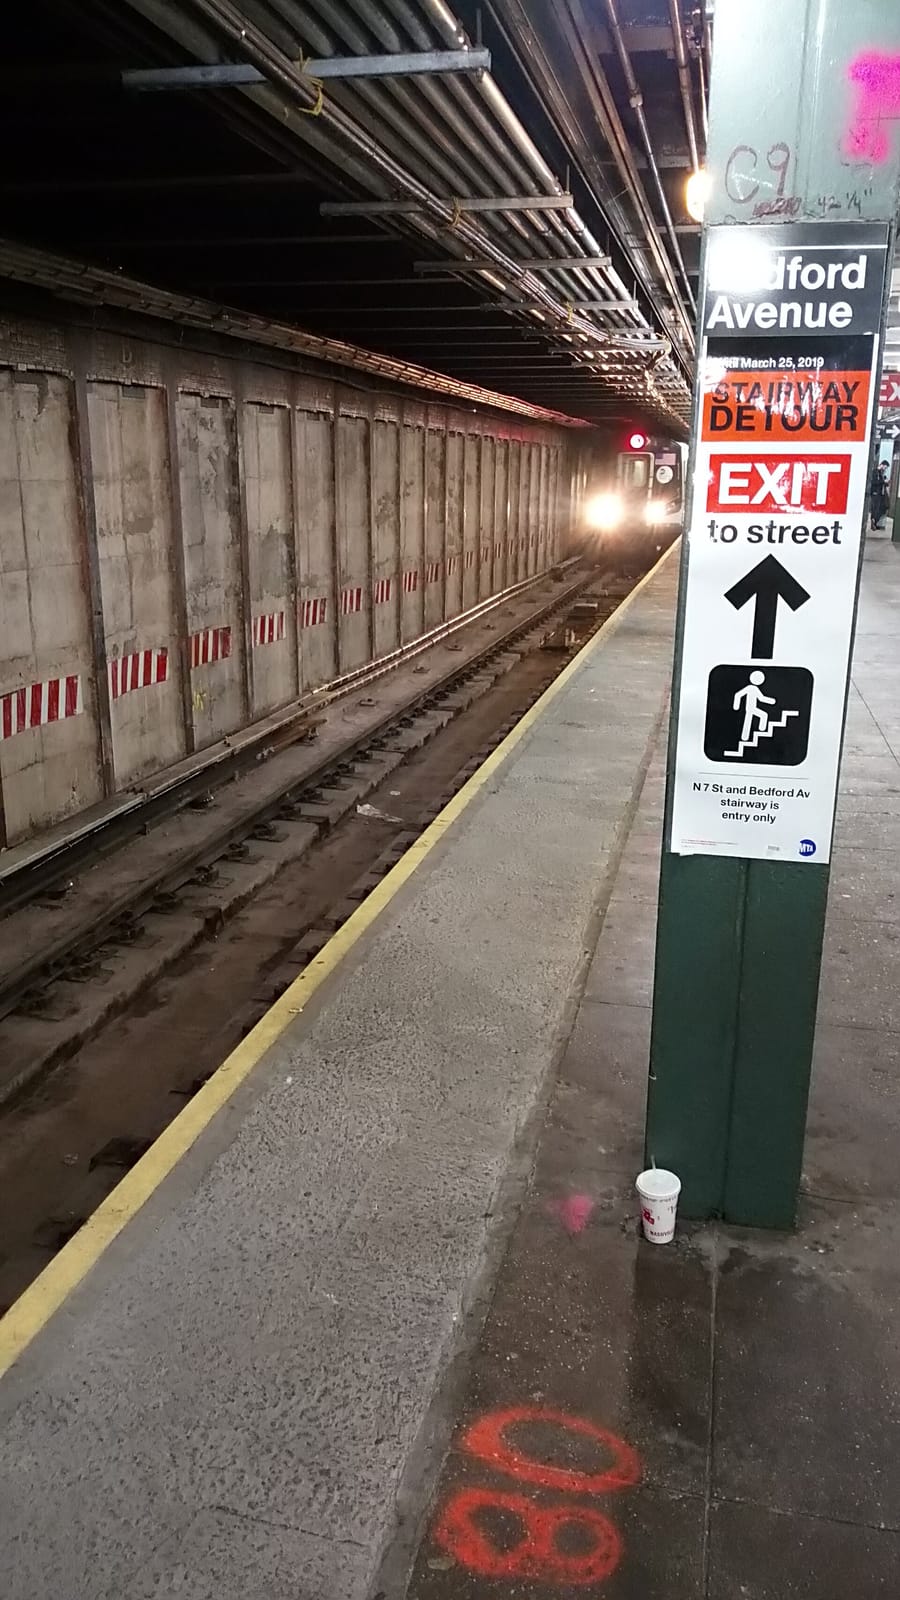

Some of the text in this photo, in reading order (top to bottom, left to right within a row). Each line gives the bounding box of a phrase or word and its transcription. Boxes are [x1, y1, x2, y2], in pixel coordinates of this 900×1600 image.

[725, 142, 790, 204] C9
[707, 255, 867, 291] dford
[706, 296, 853, 330] Avenue
[740, 357, 776, 368] March
[778, 357, 796, 369] 25,
[797, 357, 824, 368] 2019
[712, 382, 859, 404] STAIRWAY
[710, 404, 859, 431] DETOUR
[718, 461, 841, 506] EXIT
[707, 519, 843, 545] to street
[693, 783, 810, 798] N 7 St and Bedford Av
[720, 798, 780, 811] stairway is
[722, 812, 777, 824] entry only
